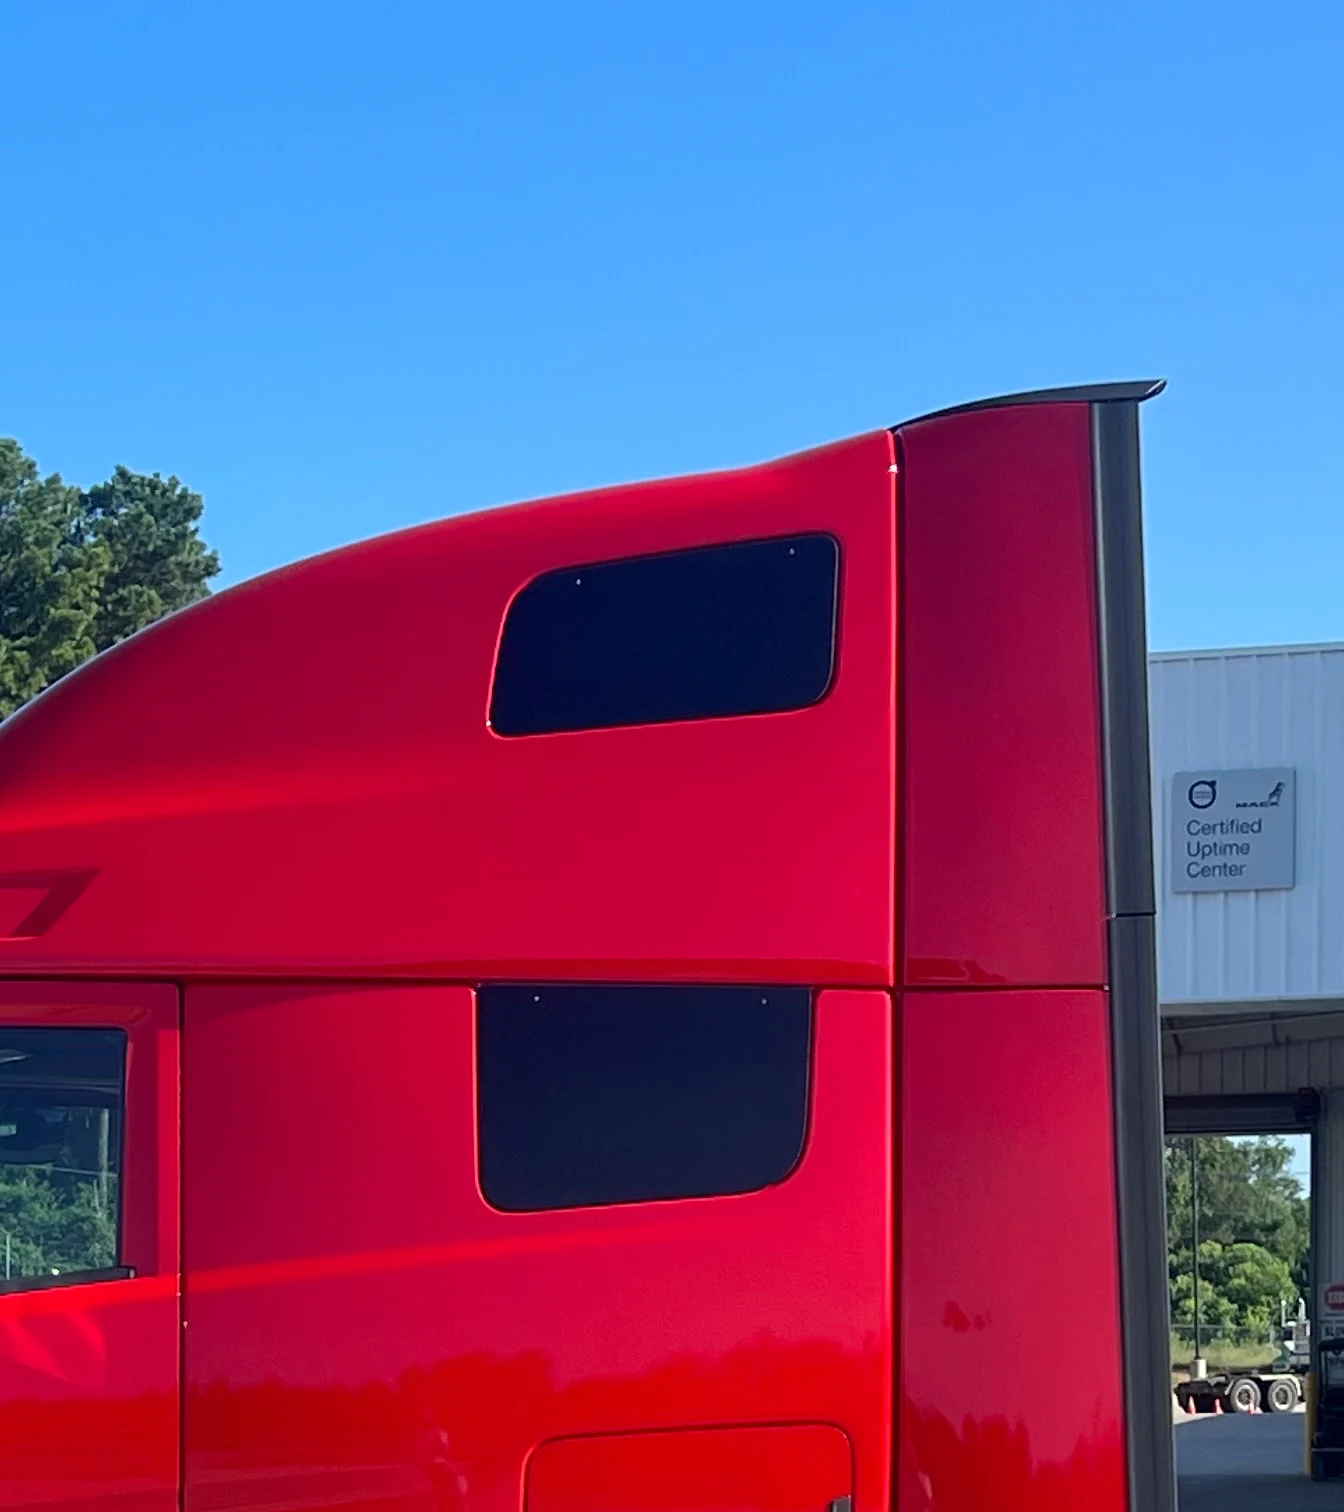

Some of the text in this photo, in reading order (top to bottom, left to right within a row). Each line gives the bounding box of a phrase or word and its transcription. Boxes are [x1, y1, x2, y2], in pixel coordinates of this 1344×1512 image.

[1186, 818, 1263, 836] Certified
[1186, 841, 1250, 860] Uptime
[1186, 861, 1247, 878] Center
